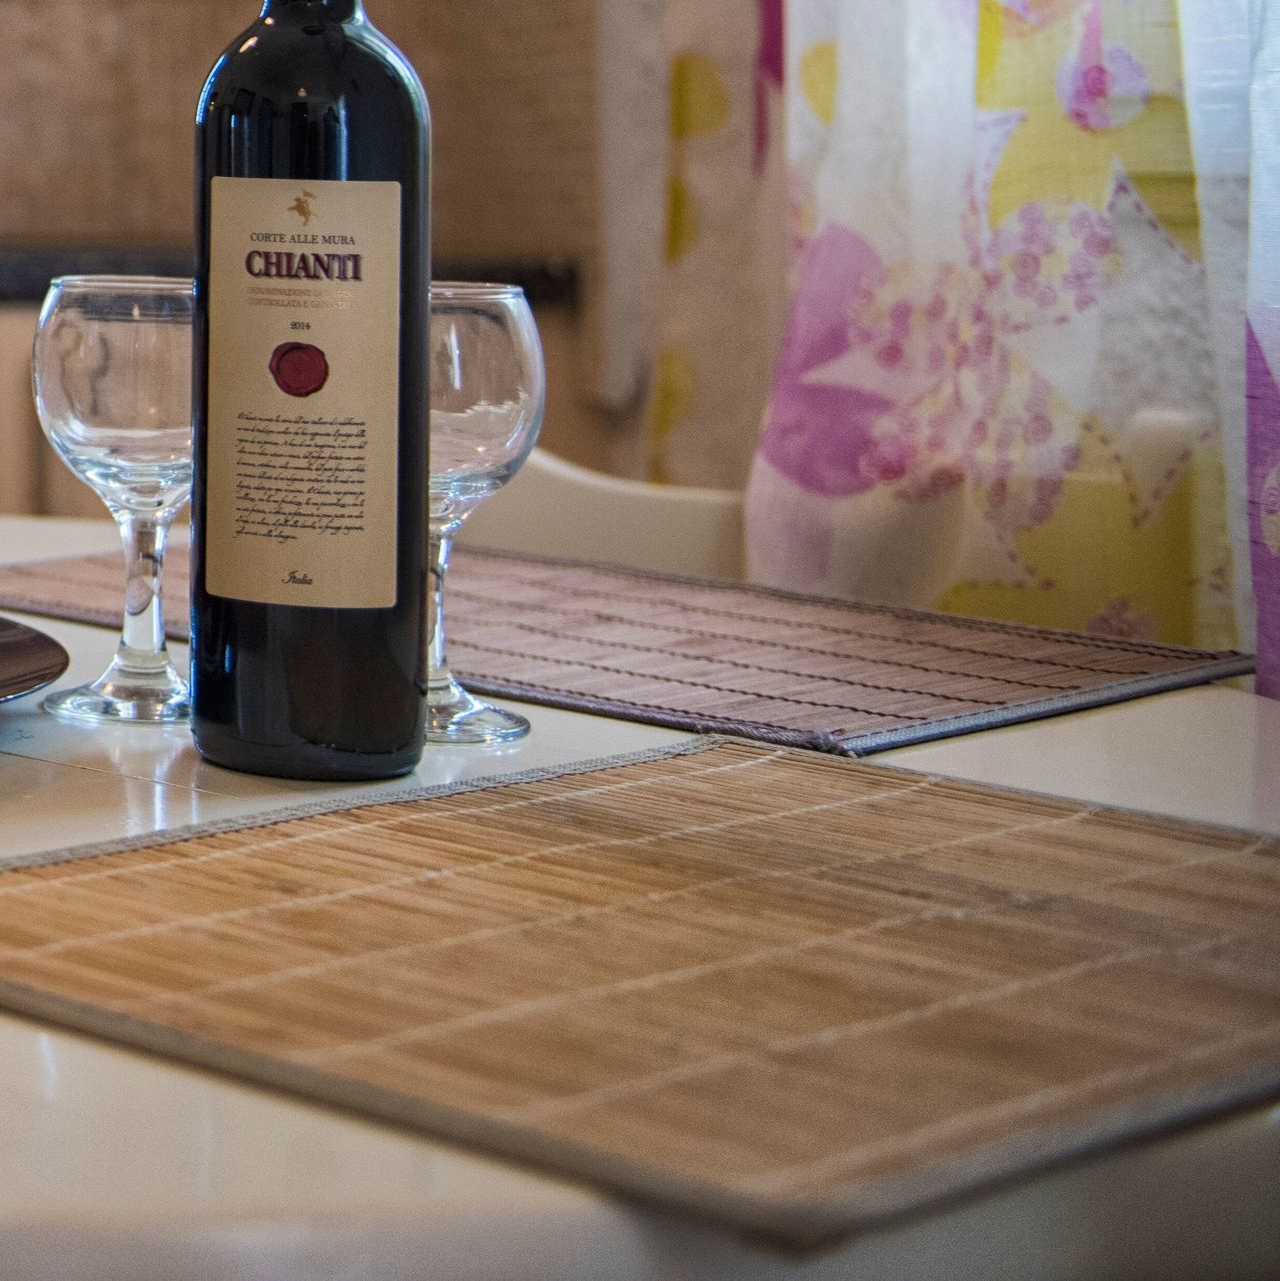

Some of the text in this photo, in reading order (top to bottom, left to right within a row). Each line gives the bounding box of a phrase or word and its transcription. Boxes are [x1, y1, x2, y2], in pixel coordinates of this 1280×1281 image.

[250, 232, 356, 245] CORTE ALLE MURA
[245, 250, 364, 282] CHIANTI
[281, 570, 313, 585] Italia
